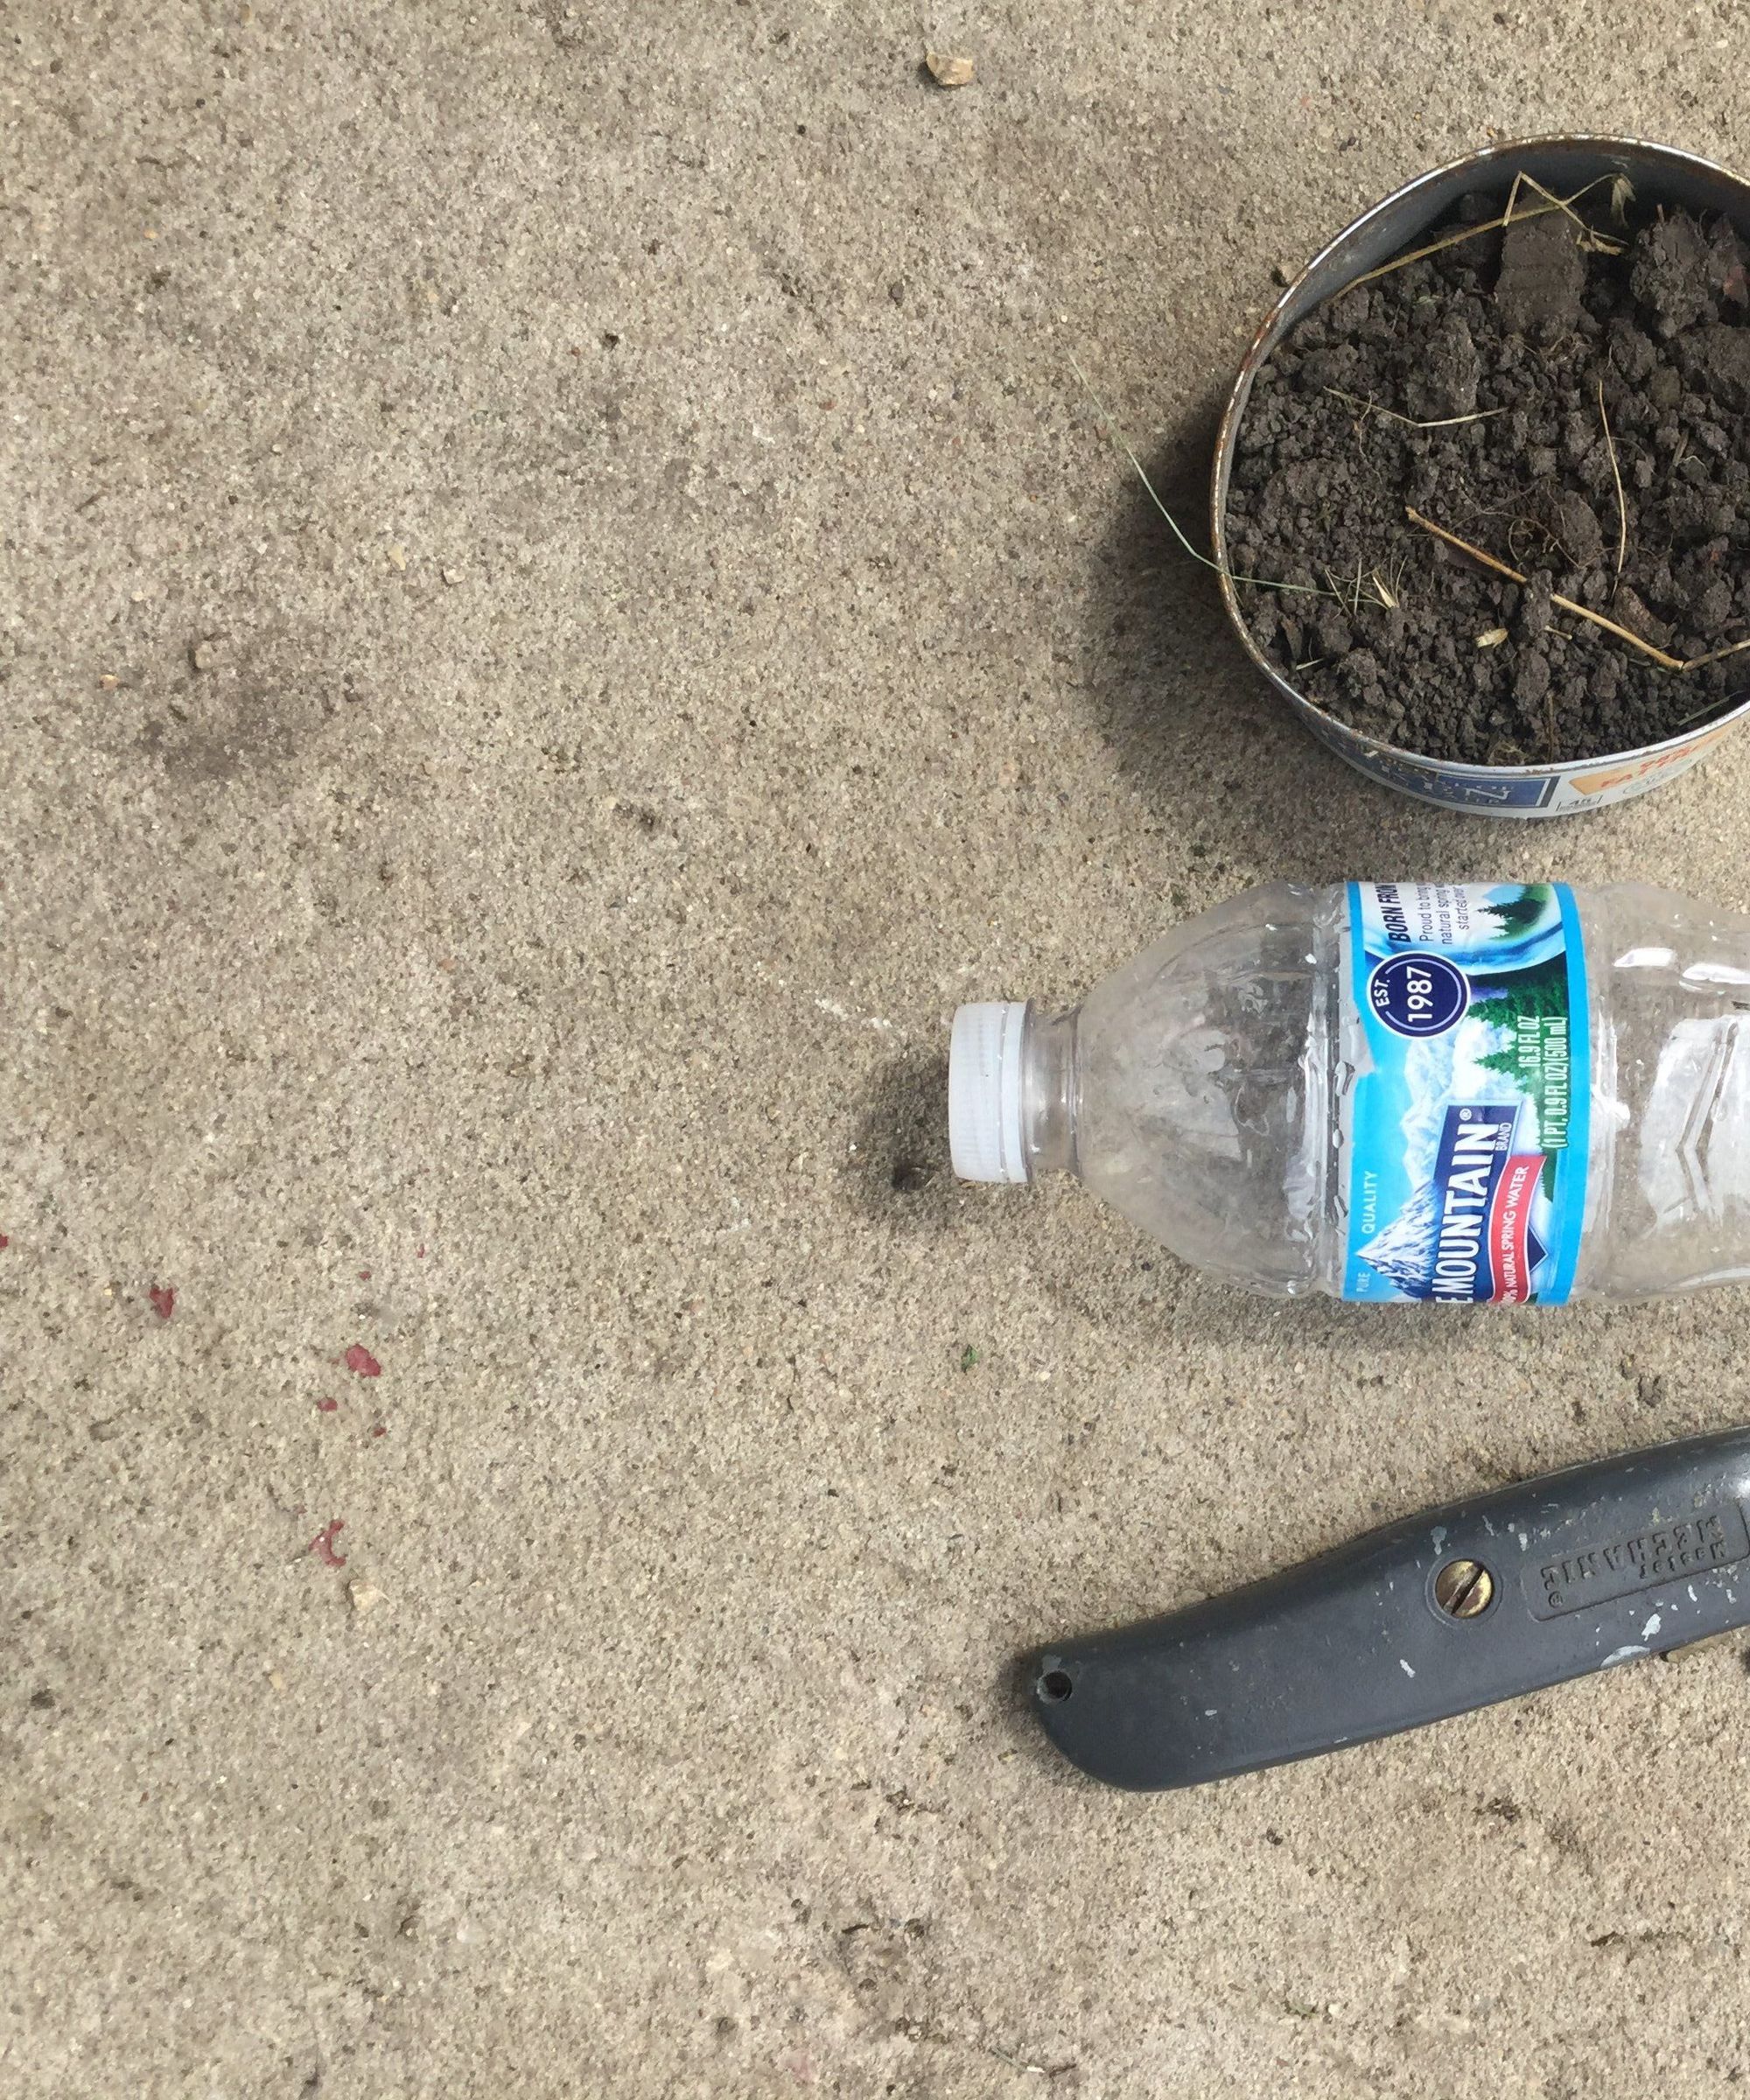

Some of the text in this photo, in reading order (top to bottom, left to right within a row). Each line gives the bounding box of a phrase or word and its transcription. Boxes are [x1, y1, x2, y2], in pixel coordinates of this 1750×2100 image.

[1382, 906, 1411, 943] BORN
[1417, 913, 1434, 942] Proud
[1435, 889, 1453, 945] natural spring
[1374, 979, 1391, 1007] EST.
[1406, 965, 1434, 1023] 1987
[1517, 1015, 1542, 1068] 16.9 FL OZ
[1541, 1016, 1569, 1035] mL)
[1544, 1082, 1567, 1096] FL
[1544, 1097, 1567, 1116] 0.9
[1494, 1123, 1513, 1152] BRAND
[1541, 1138, 1568, 1149] (1
[1507, 1166, 1530, 1208] WATER
[1432, 1124, 1500, 1295] MOUNTAIN
[1356, 1170, 1378, 1292] PURE QUALITY
[1501, 1211, 1517, 1251] SPRING
[1502, 1251, 1518, 1288] NATURAL
[1540, 1515, 1726, 1590] MECHANIC
[1639, 1539, 1726, 1579] Master
